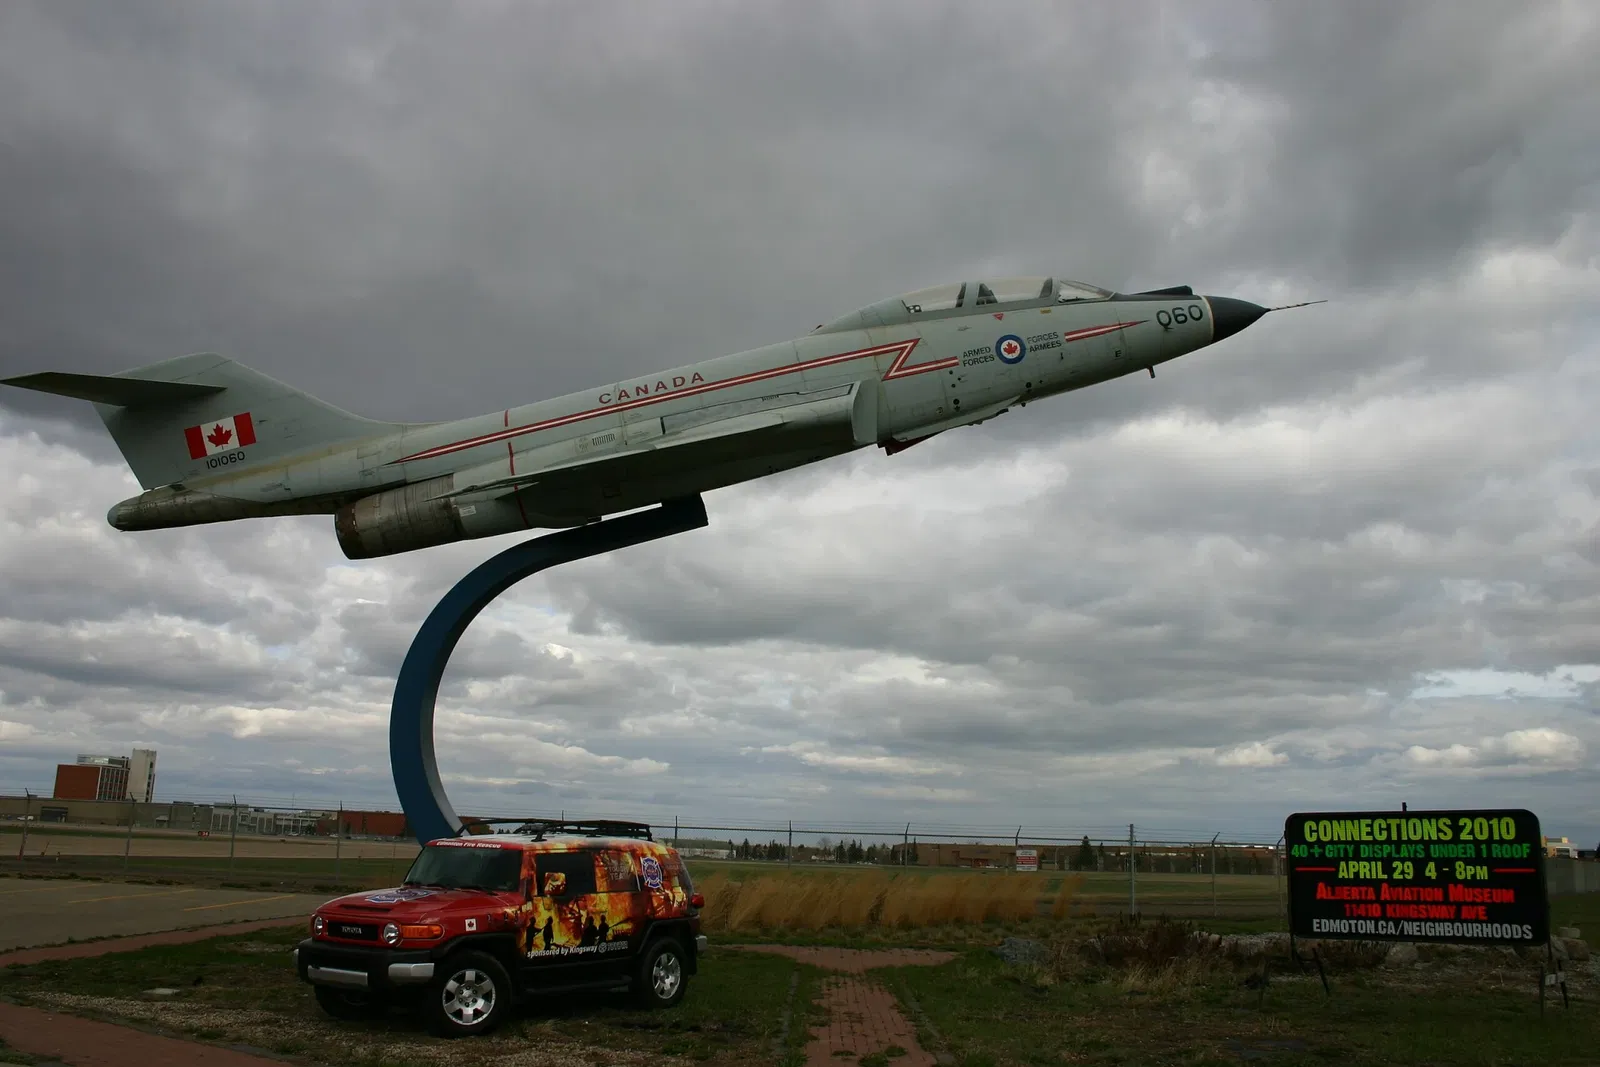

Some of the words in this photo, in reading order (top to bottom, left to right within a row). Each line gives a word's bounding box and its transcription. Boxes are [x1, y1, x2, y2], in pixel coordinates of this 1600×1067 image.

[1156, 304, 1204, 332] Q60
[1027, 331, 1059, 344] FORCES
[962, 346, 992, 358] ARMED
[962, 354, 995, 367] FORCES
[598, 372, 704, 404] CANADA
[206, 451, 245, 469] 101060
[1304, 818, 1453, 842] CONNECTIONS
[1458, 817, 1516, 840] 2010
[1360, 844, 1425, 858] DISPLAYS
[1430, 844, 1476, 858] UNDER
[1480, 844, 1487, 858] 1
[1491, 844, 1531, 858] ROOF
[1338, 861, 1388, 879] APRIL
[1392, 861, 1414, 879] 29
[1425, 861, 1437, 880] 4
[1344, 903, 1382, 917] 11410
[1386, 903, 1457, 919] KINGSWAY
[1461, 905, 1488, 920] AVE
[527, 947, 560, 958] sponsored
[561, 946, 569, 956] by
[569, 945, 598, 955] Kingsway
